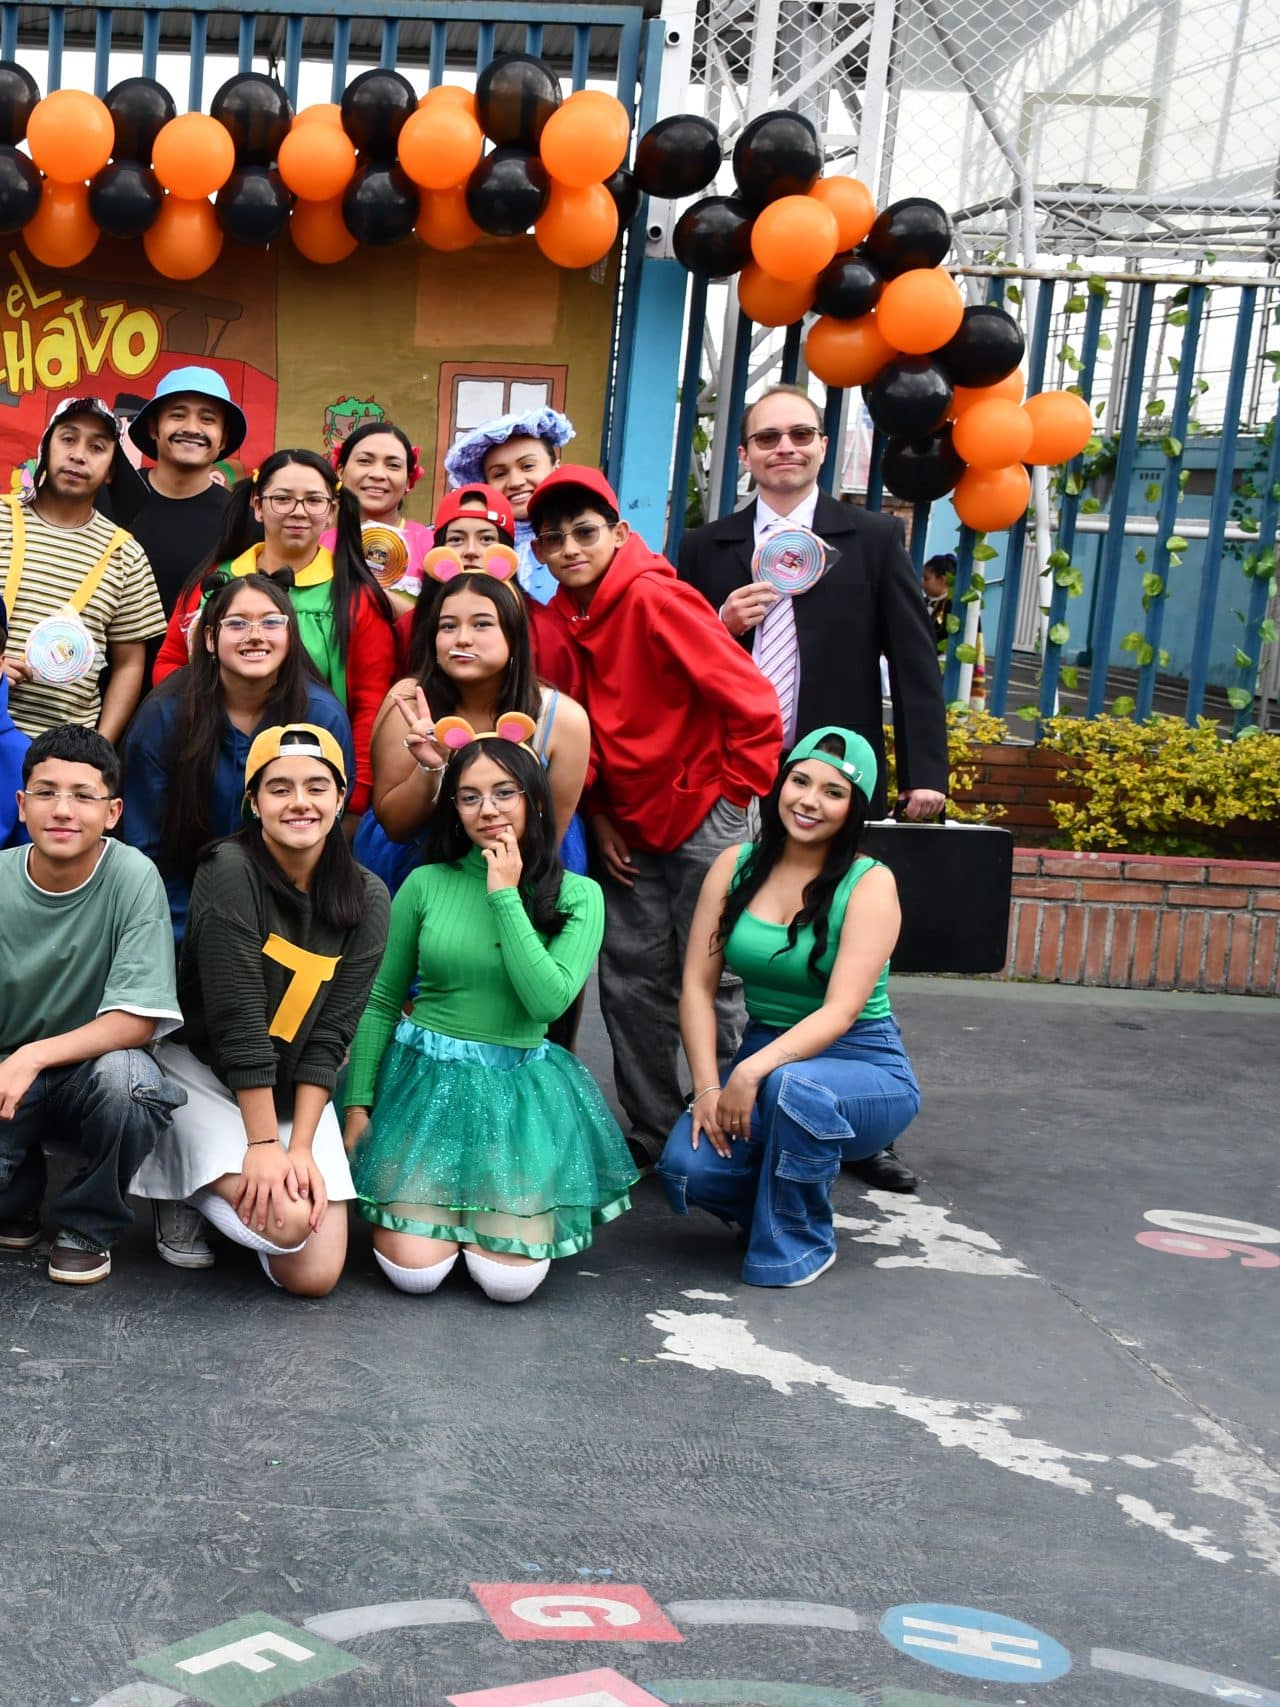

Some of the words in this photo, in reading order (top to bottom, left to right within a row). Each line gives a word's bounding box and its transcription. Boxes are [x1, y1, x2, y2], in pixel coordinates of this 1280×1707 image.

[261, 932, 343, 1044] T
[510, 1595, 641, 1628] G
[174, 1631, 316, 1675] F
[902, 1615, 1042, 1669] H
